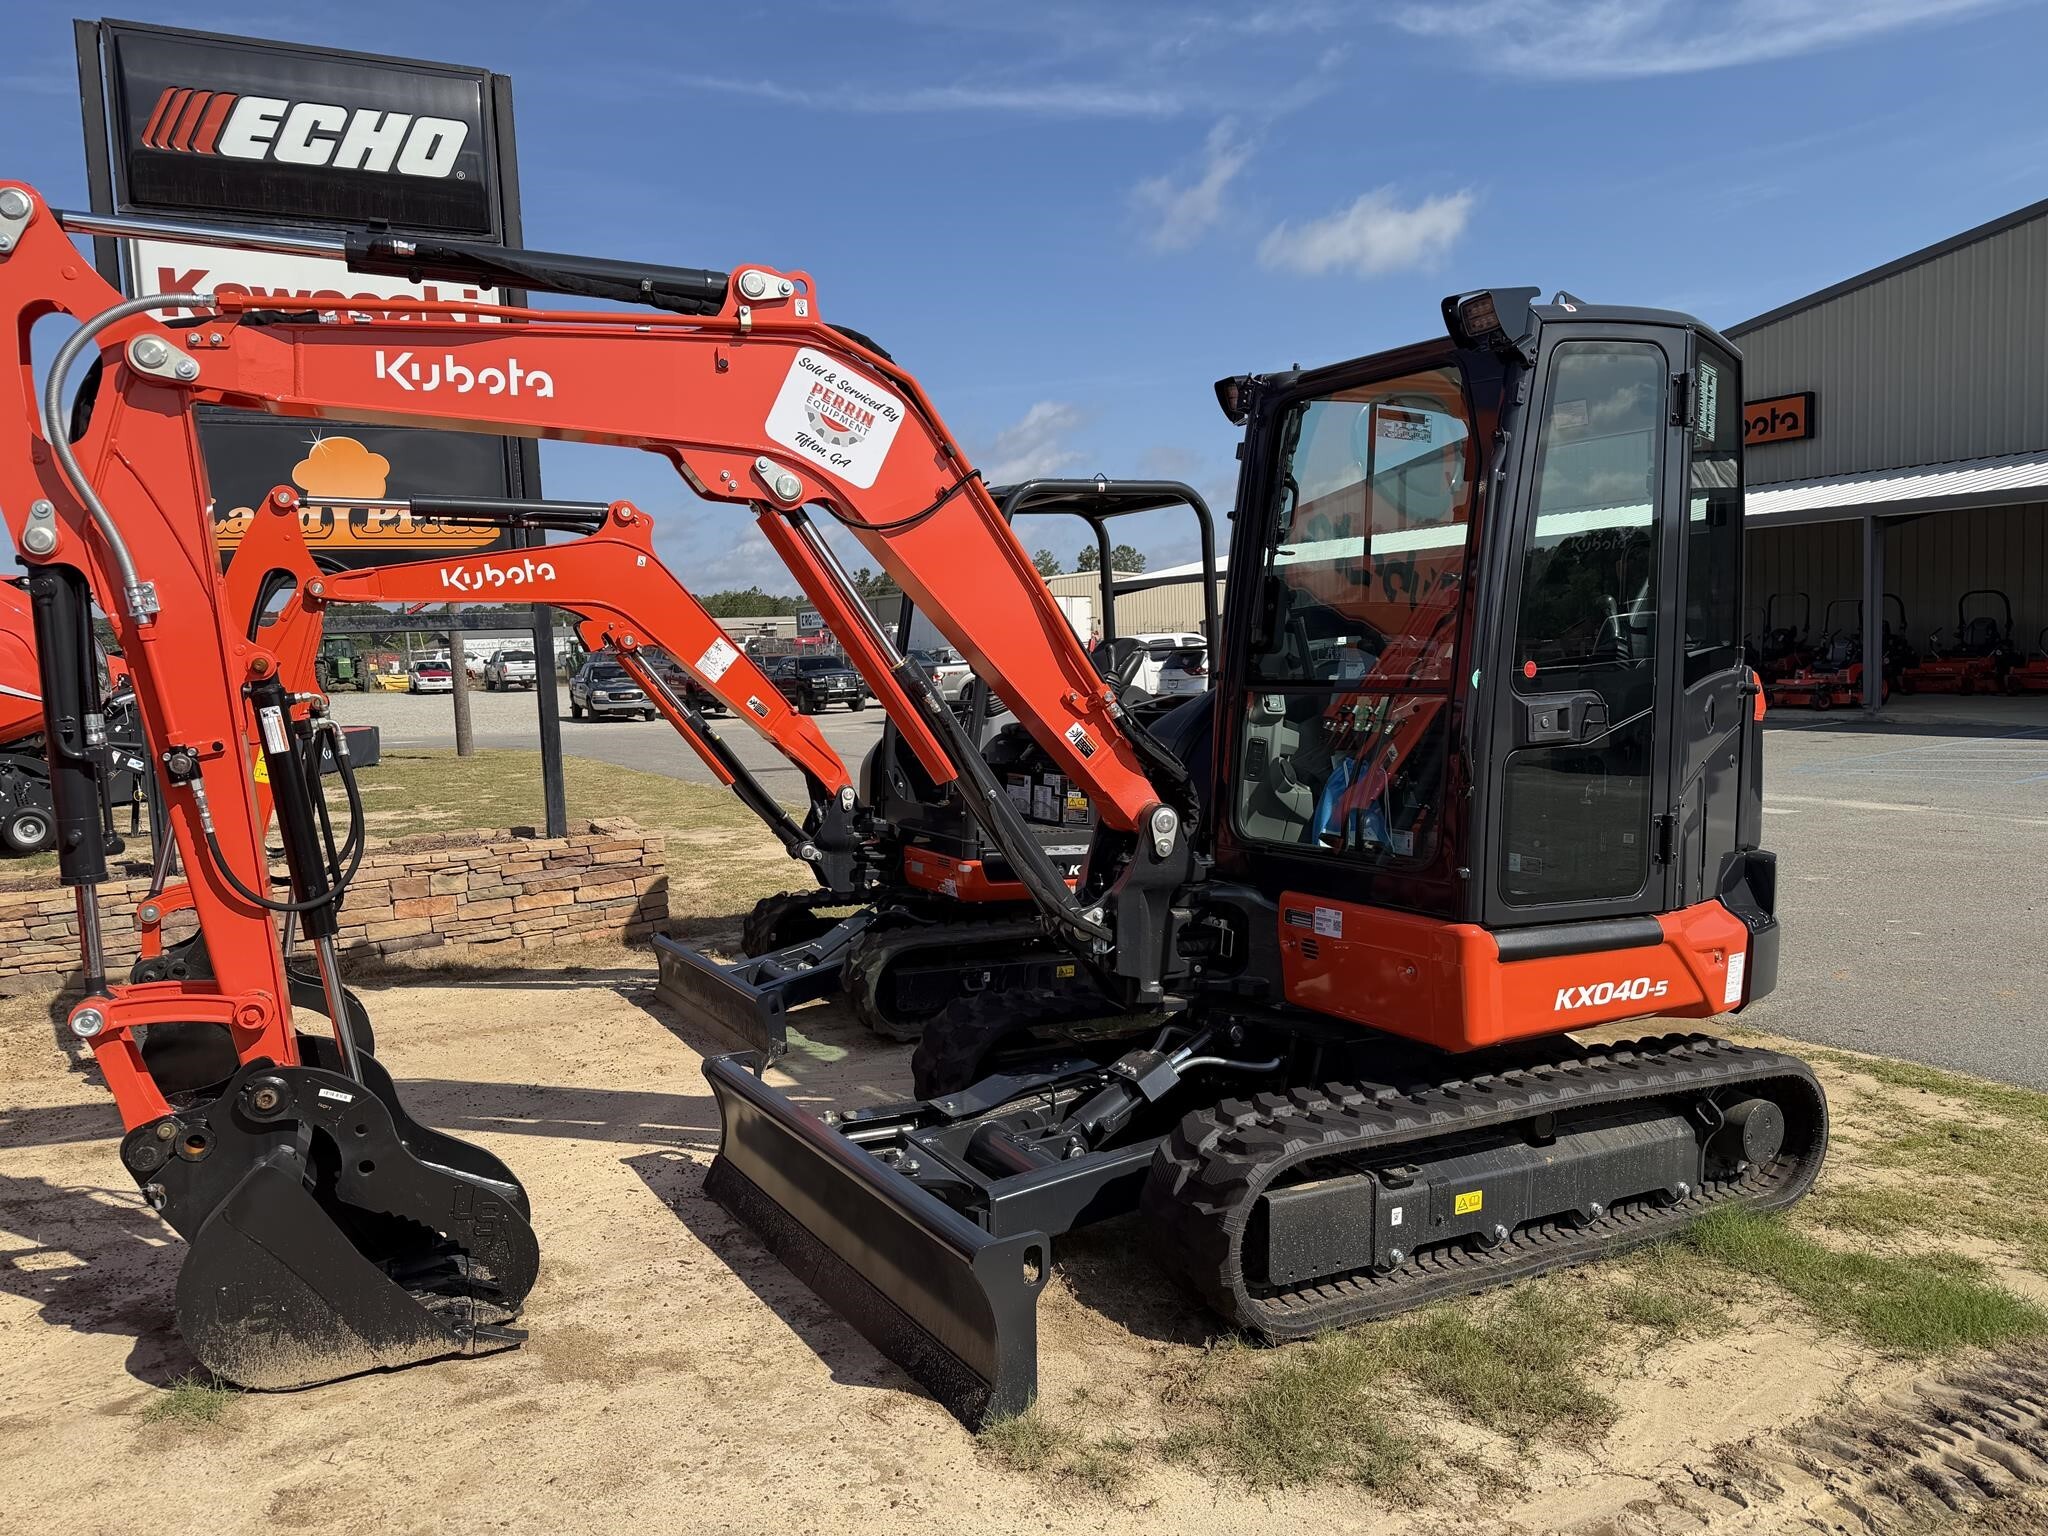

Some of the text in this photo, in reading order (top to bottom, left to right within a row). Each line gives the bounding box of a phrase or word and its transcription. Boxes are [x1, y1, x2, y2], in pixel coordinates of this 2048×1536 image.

[218, 95, 469, 178] ECHO
[375, 350, 554, 398] Kubota
[798, 357, 900, 423] Sold & Serviced By
[805, 395, 870, 436] EQUIPMENT
[810, 381, 876, 429] PERRIN
[1744, 407, 1799, 436] ota
[794, 431, 852, 468] Tifton, GA
[440, 558, 557, 592] Kubota
[1554, 977, 1669, 1011] KX040-5
